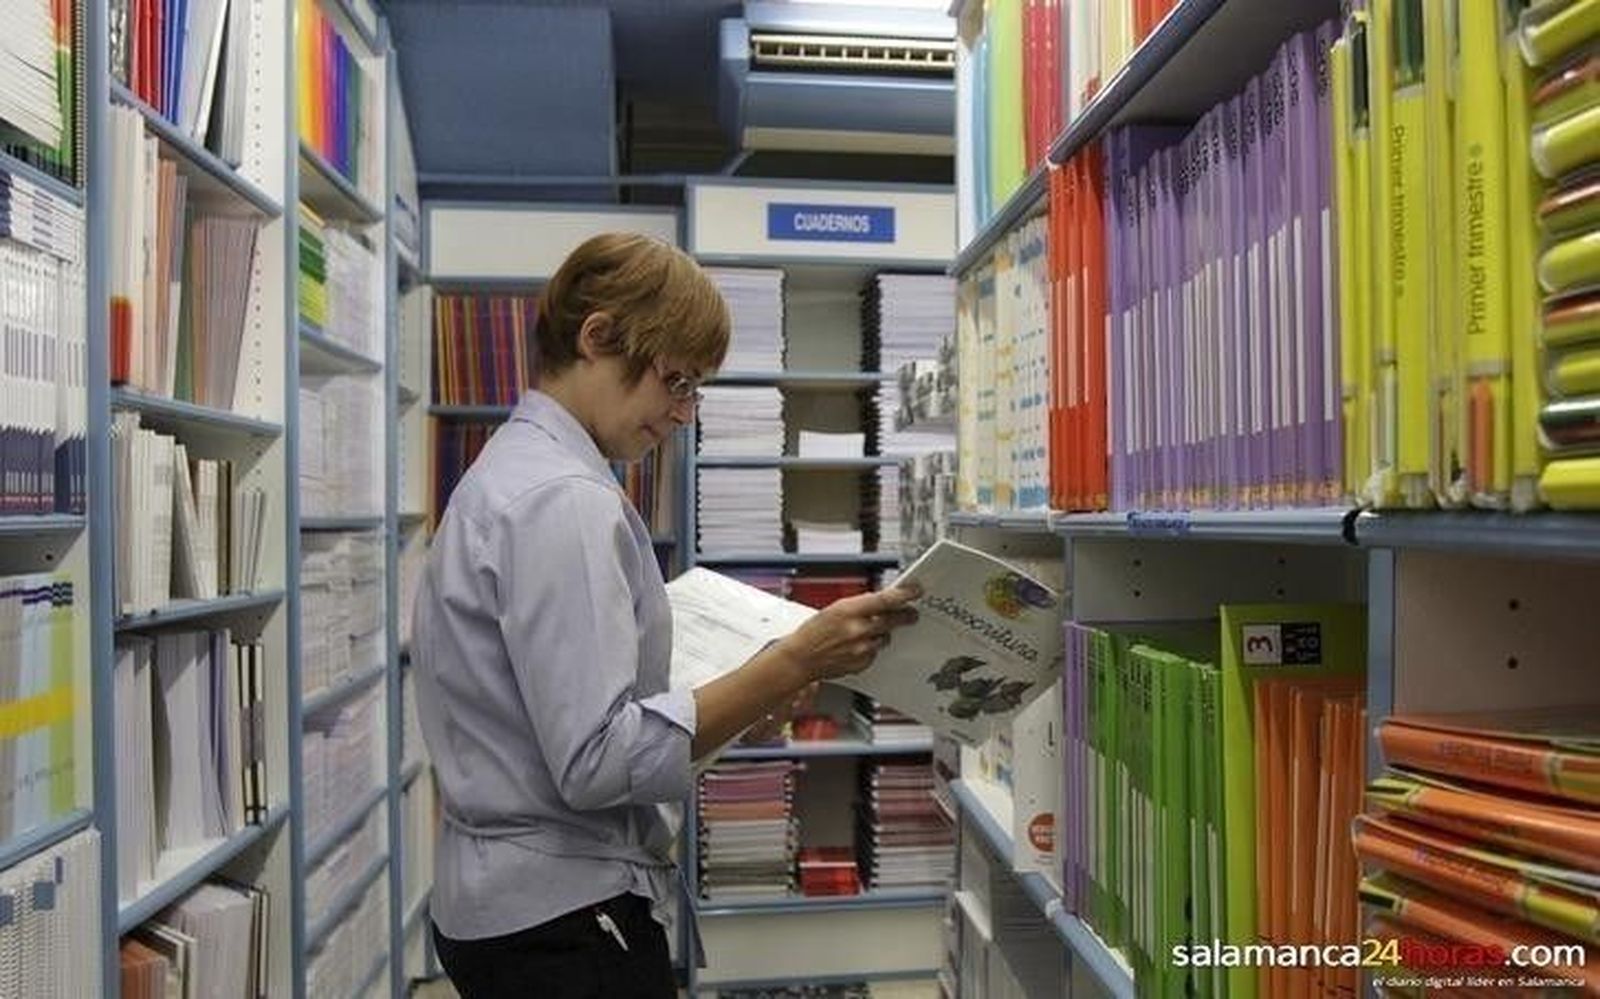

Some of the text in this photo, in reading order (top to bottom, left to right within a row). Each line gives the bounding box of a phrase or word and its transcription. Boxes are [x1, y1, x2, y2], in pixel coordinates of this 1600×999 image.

[794, 212, 870, 233] CUADERNOS
[1466, 160, 1487, 335] Primer trimestre
[1247, 635, 1273, 653] 3
